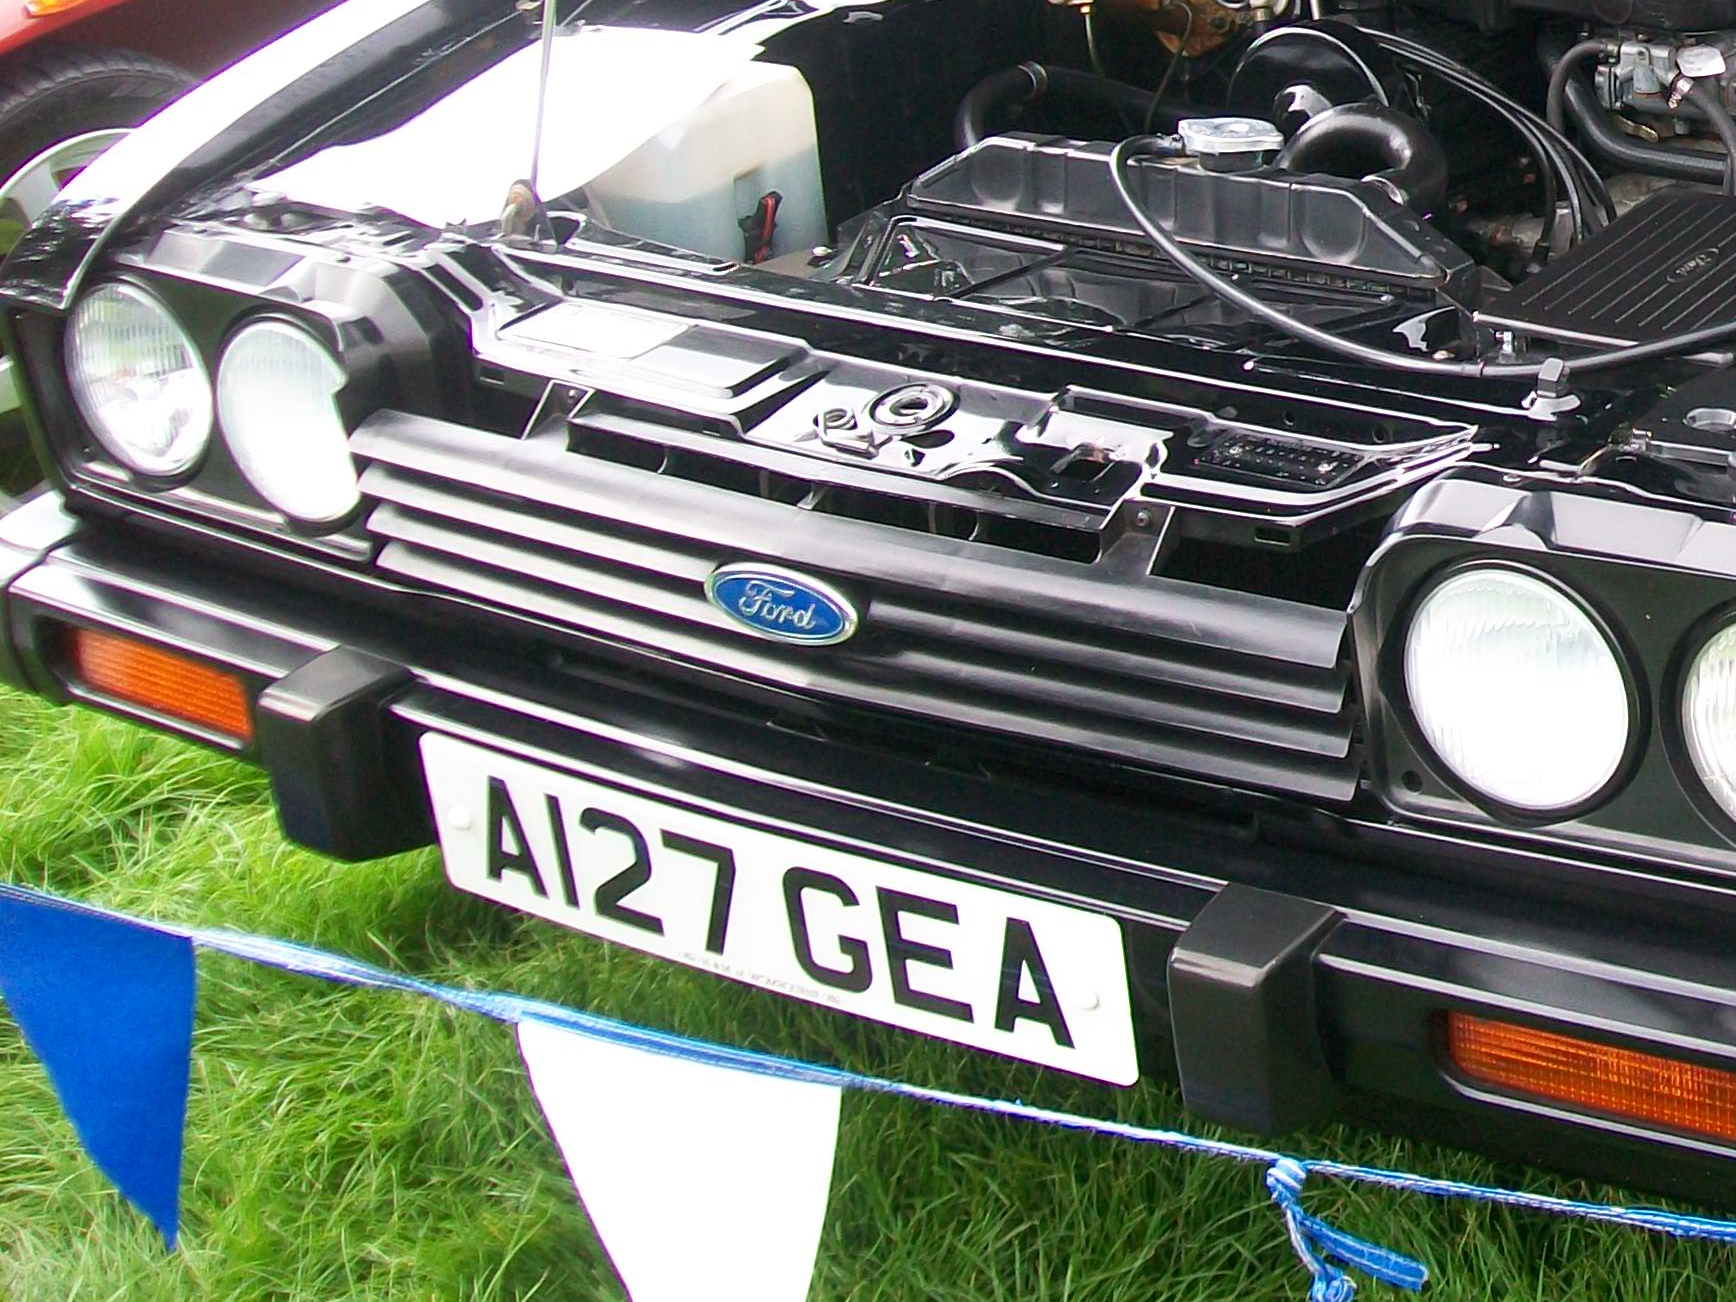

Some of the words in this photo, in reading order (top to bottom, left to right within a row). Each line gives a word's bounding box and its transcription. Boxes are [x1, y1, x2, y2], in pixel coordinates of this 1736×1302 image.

[738, 579, 816, 630] Ford
[487, 776, 737, 956] A127
[782, 865, 1076, 1050] GEA
